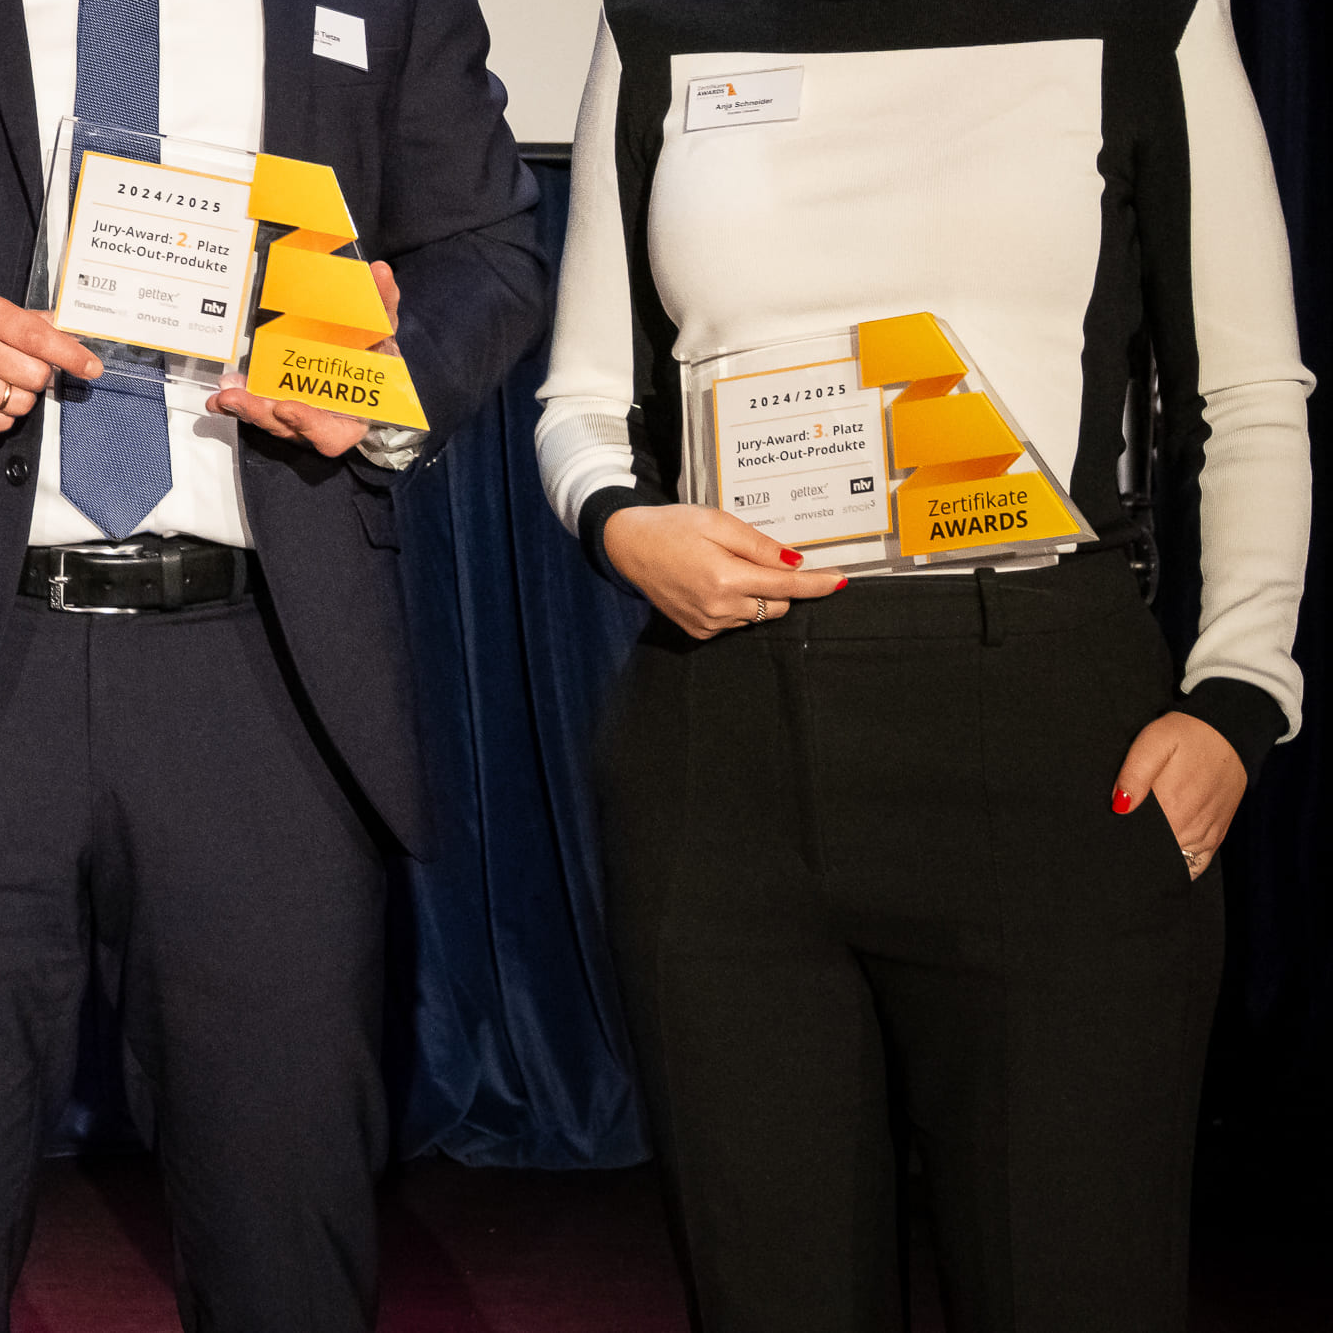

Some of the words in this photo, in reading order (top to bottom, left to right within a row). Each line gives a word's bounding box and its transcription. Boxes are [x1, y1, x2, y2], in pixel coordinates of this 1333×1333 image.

[735, 98, 774, 108] Schneider
[92, 219, 173, 245] Jury-Award:
[175, 232, 193, 249] 2.
[196, 239, 231, 257] Platz
[90, 236, 229, 273] Knock-Out-Produkte
[91, 276, 117, 292] DZB
[137, 312, 180, 327] onvista
[203, 302, 225, 315] ntv
[282, 349, 386, 386] Zertifikate
[279, 372, 381, 408] AWARDS
[736, 429, 810, 454] Jury-Award:
[812, 423, 829, 440] 3.
[832, 422, 865, 436] Platz
[737, 438, 867, 469] Knock-Out-Produkte
[746, 491, 771, 506] DZB
[852, 479, 872, 492] ntv
[794, 509, 834, 521] onvista
[928, 488, 1029, 518] Zertifikate
[929, 510, 1029, 542] AWARDS
